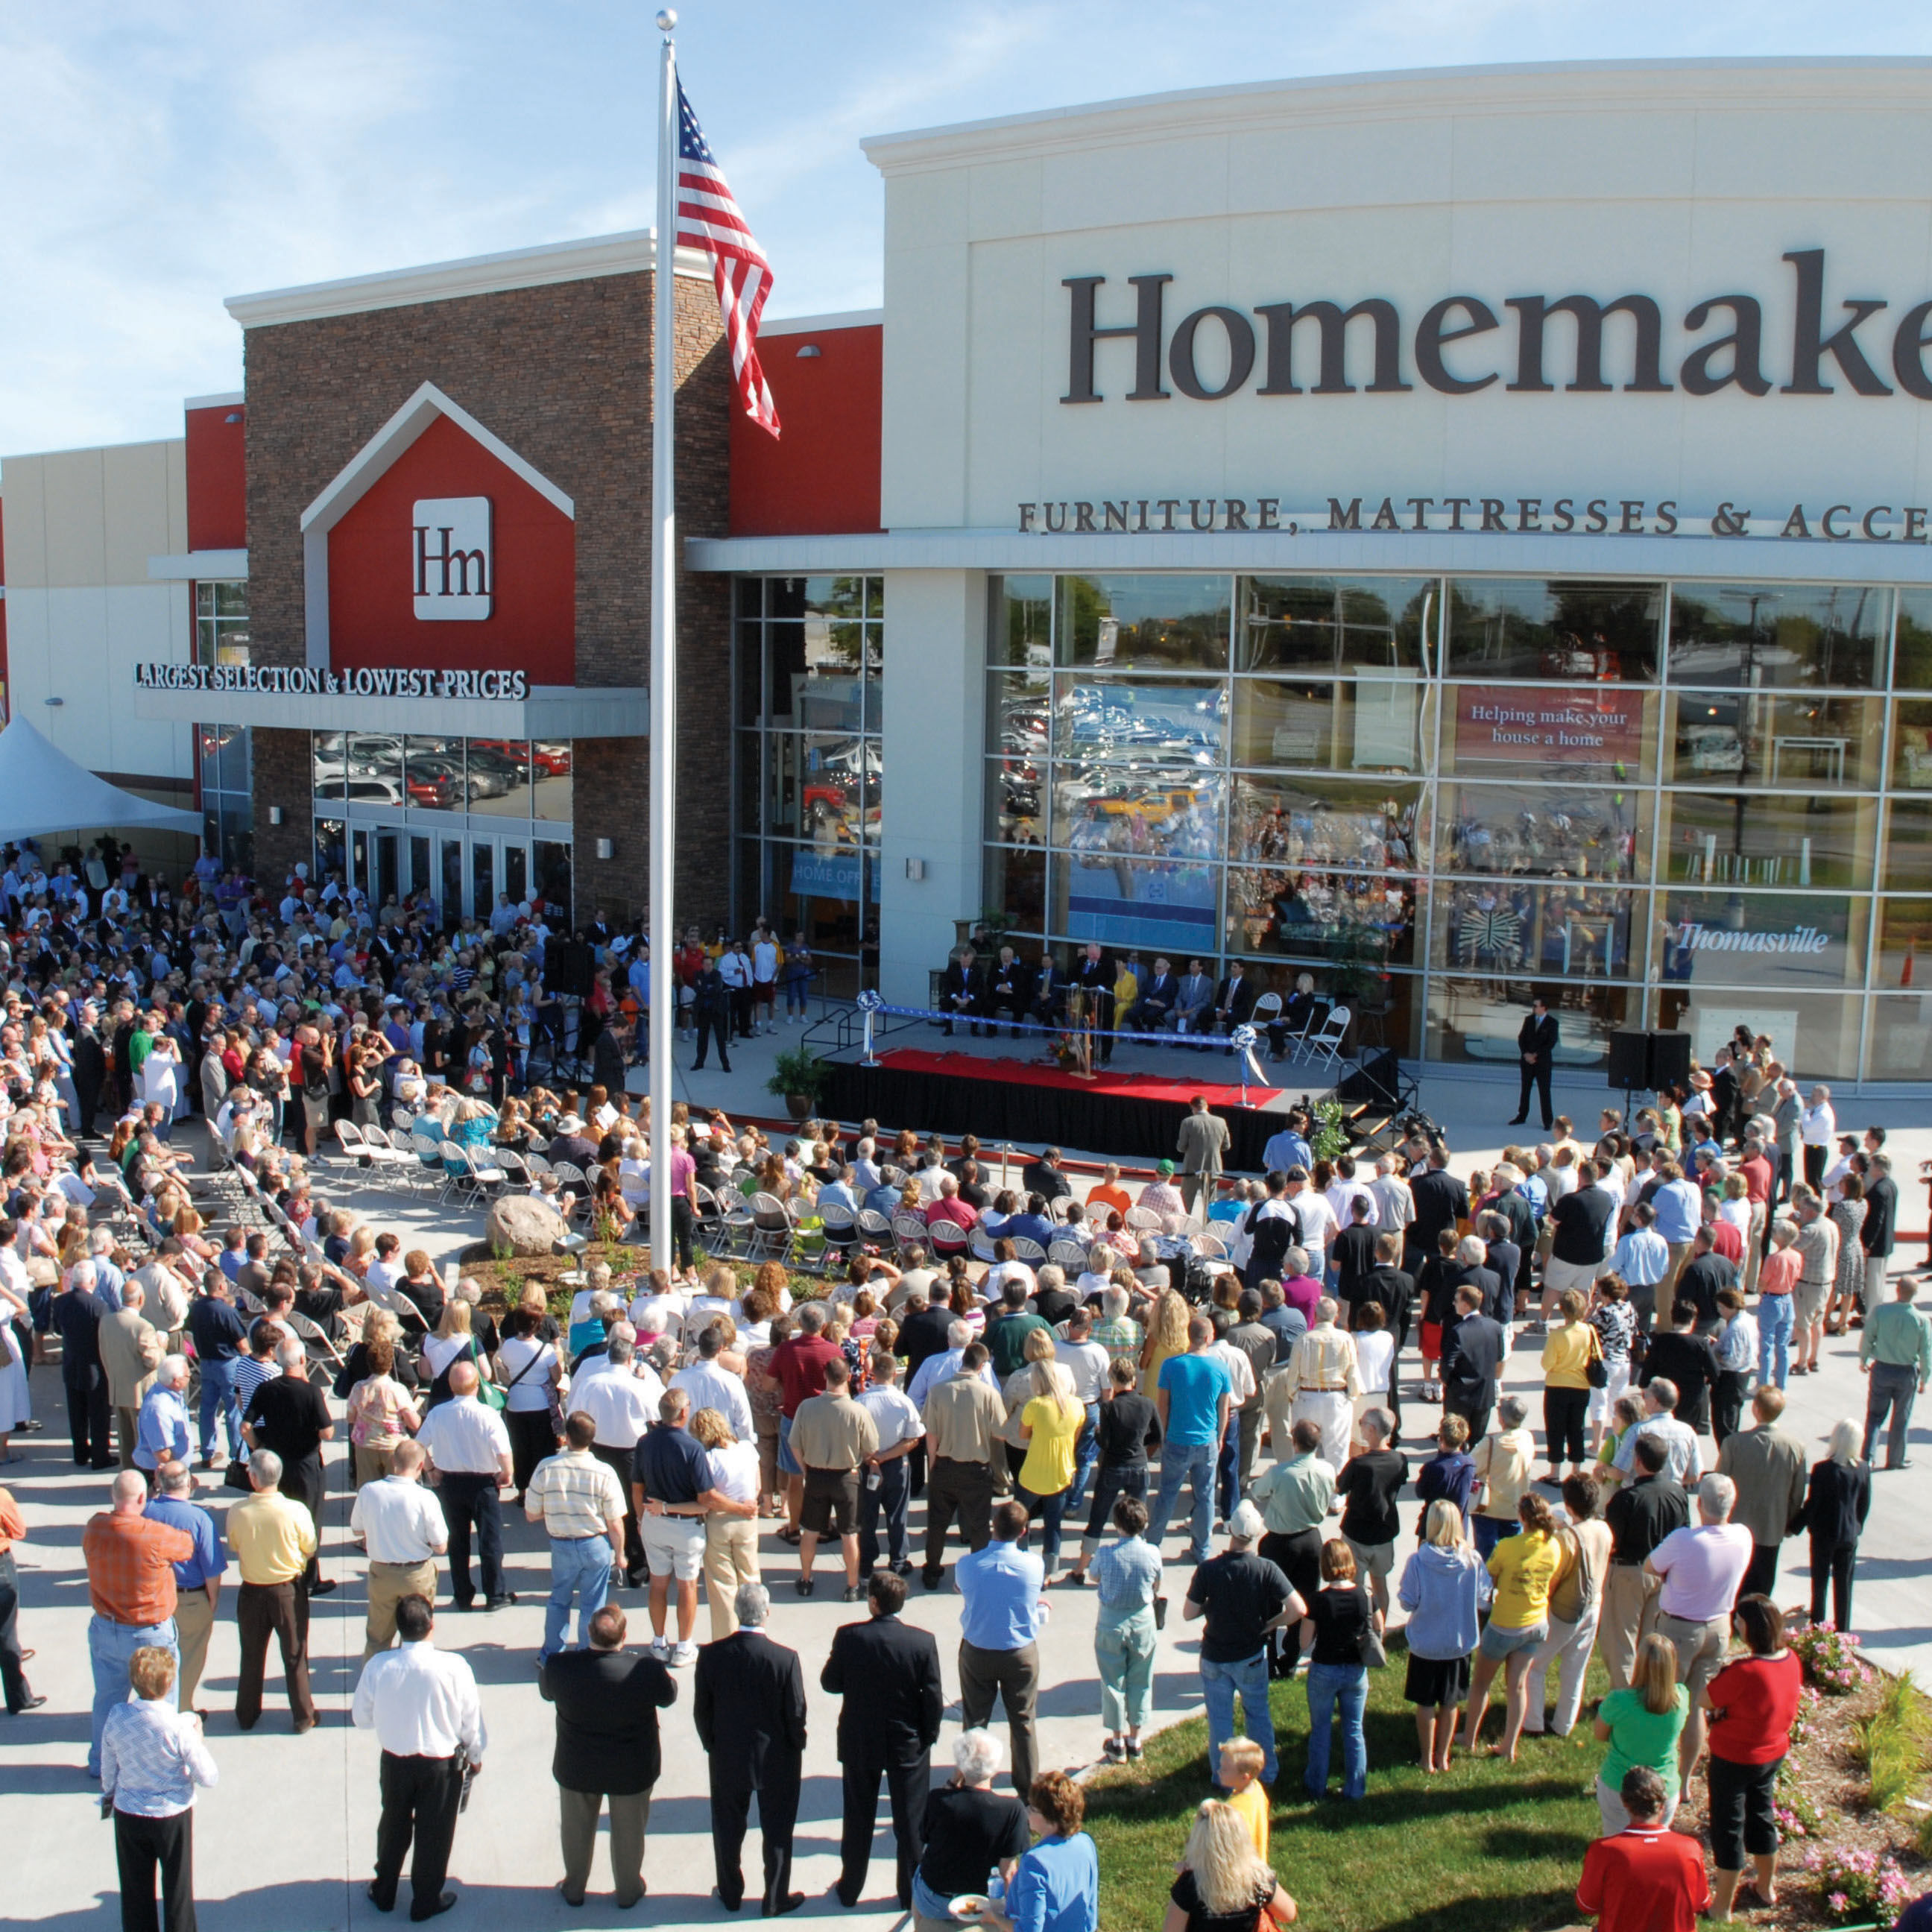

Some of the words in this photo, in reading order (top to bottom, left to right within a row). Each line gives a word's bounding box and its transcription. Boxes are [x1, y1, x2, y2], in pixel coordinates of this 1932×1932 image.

[1018, 496, 1298, 536] FURNITURE,
[1327, 497, 1678, 536] MATTRESSES
[1711, 502, 1751, 537] &
[1780, 504, 1928, 546] ACCE
[413, 525, 492, 597] Hm
[133, 663, 209, 690] LARGEST
[214, 665, 321, 694] SELECTION
[326, 673, 339, 695] &
[344, 668, 436, 698] LOWEST
[442, 669, 526, 701] PRICES
[1471, 705, 1536, 725] Helping
[1541, 709, 1585, 724] make
[1589, 713, 1628, 728] your
[1492, 727, 1540, 745] house
[1545, 734, 1554, 745] a
[1559, 730, 1603, 746] home
[794, 865, 833, 883] HOME
[1677, 922, 1829, 954] Thomasville
